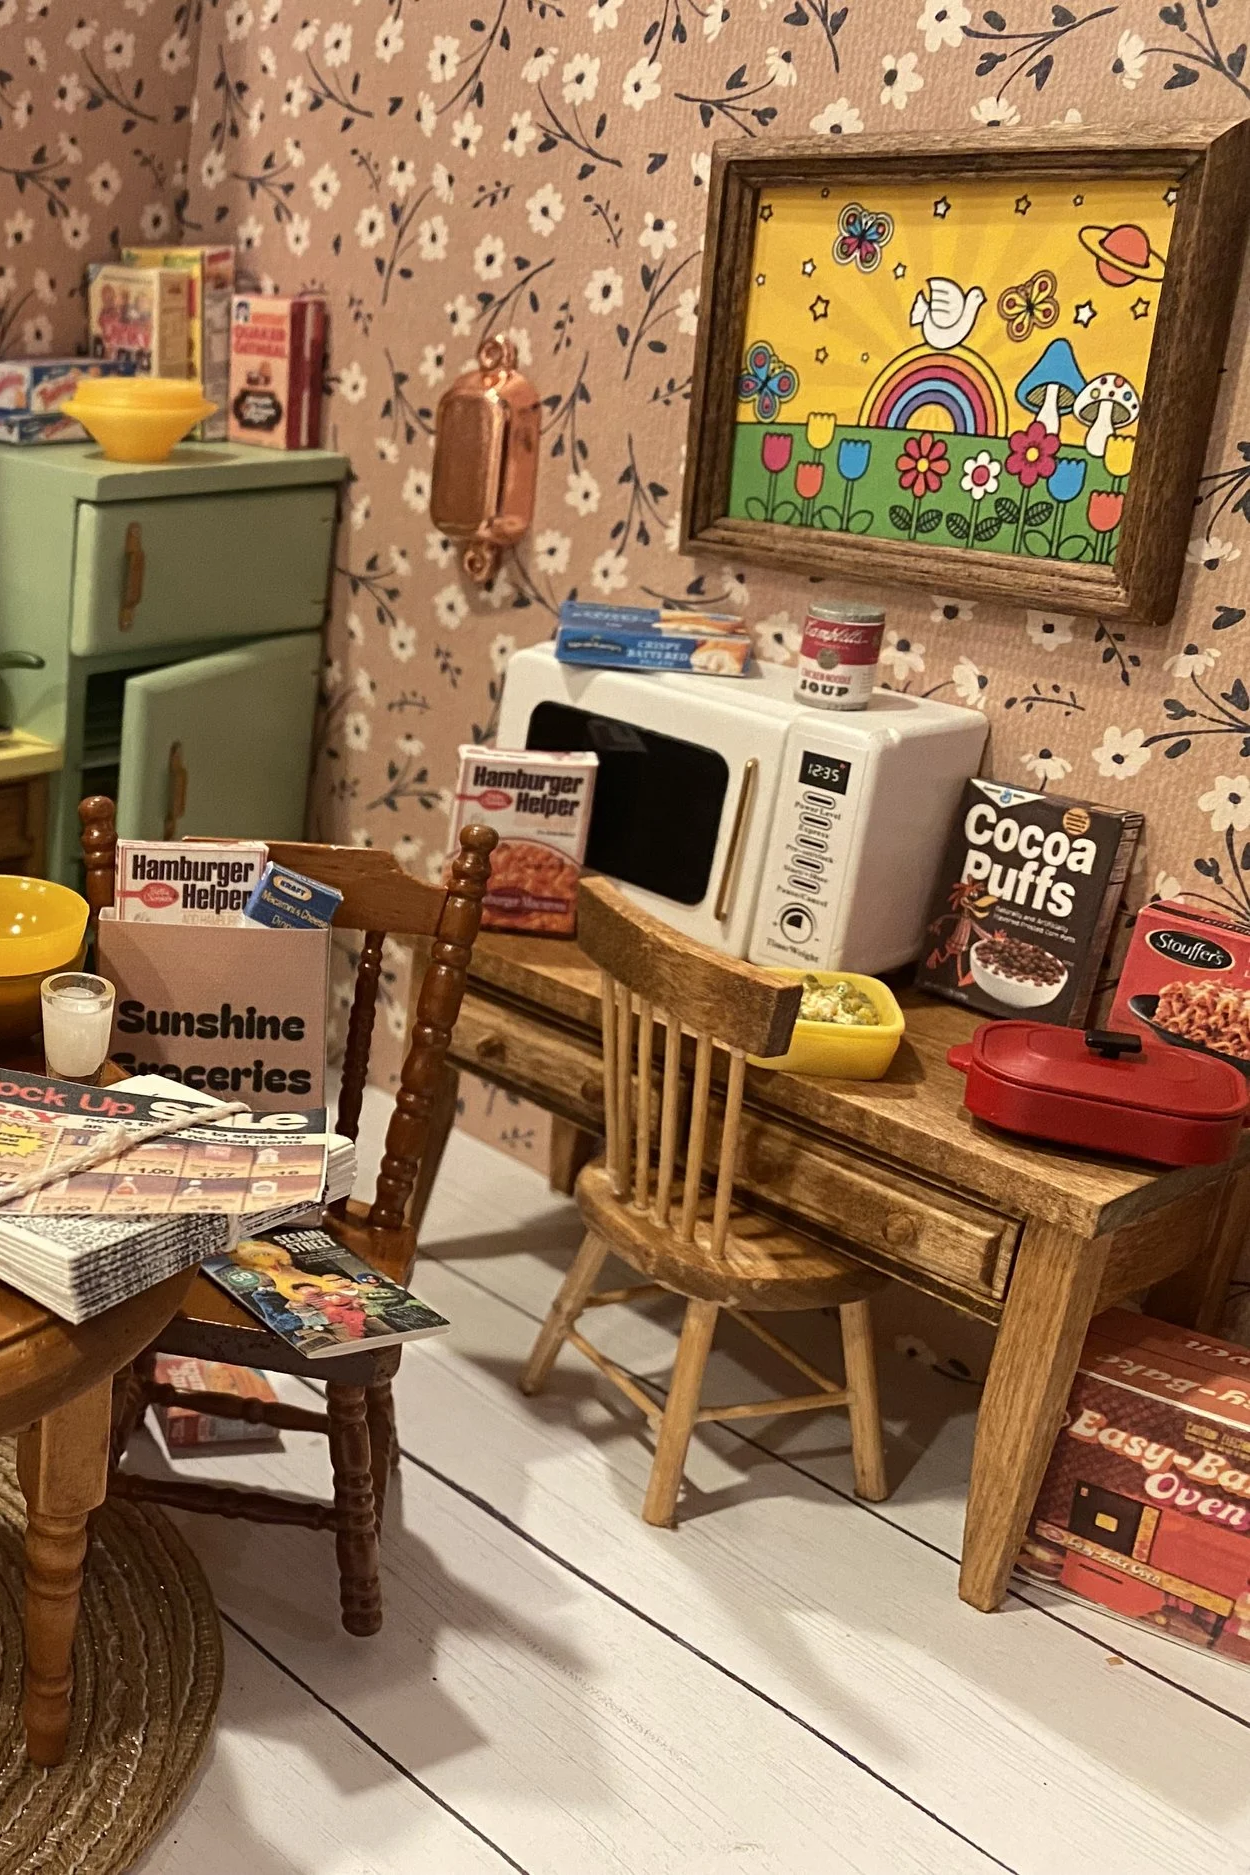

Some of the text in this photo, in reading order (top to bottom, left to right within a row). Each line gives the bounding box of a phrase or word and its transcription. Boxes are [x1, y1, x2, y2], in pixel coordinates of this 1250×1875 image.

[800, 679, 849, 697] SOUP
[473, 766, 584, 796] Hamburger
[515, 792, 580, 819] Helper
[964, 803, 1097, 875] Cocoa
[132, 854, 254, 888] Hamburger
[960, 849, 1076, 918] Puffs
[182, 884, 253, 915] Helper
[280, 878, 307, 897] KRAFT
[1156, 933, 1225, 965] Stouffer's
[117, 1000, 305, 1041] Sunshine
[79, 1093, 137, 1117] Up
[285, 1134, 307, 1142] up
[273, 1229, 330, 1246] SESAME
[286, 1237, 338, 1253] STREET
[230, 1272, 253, 1282] 50
[1144, 1473, 1246, 1526] Oven
